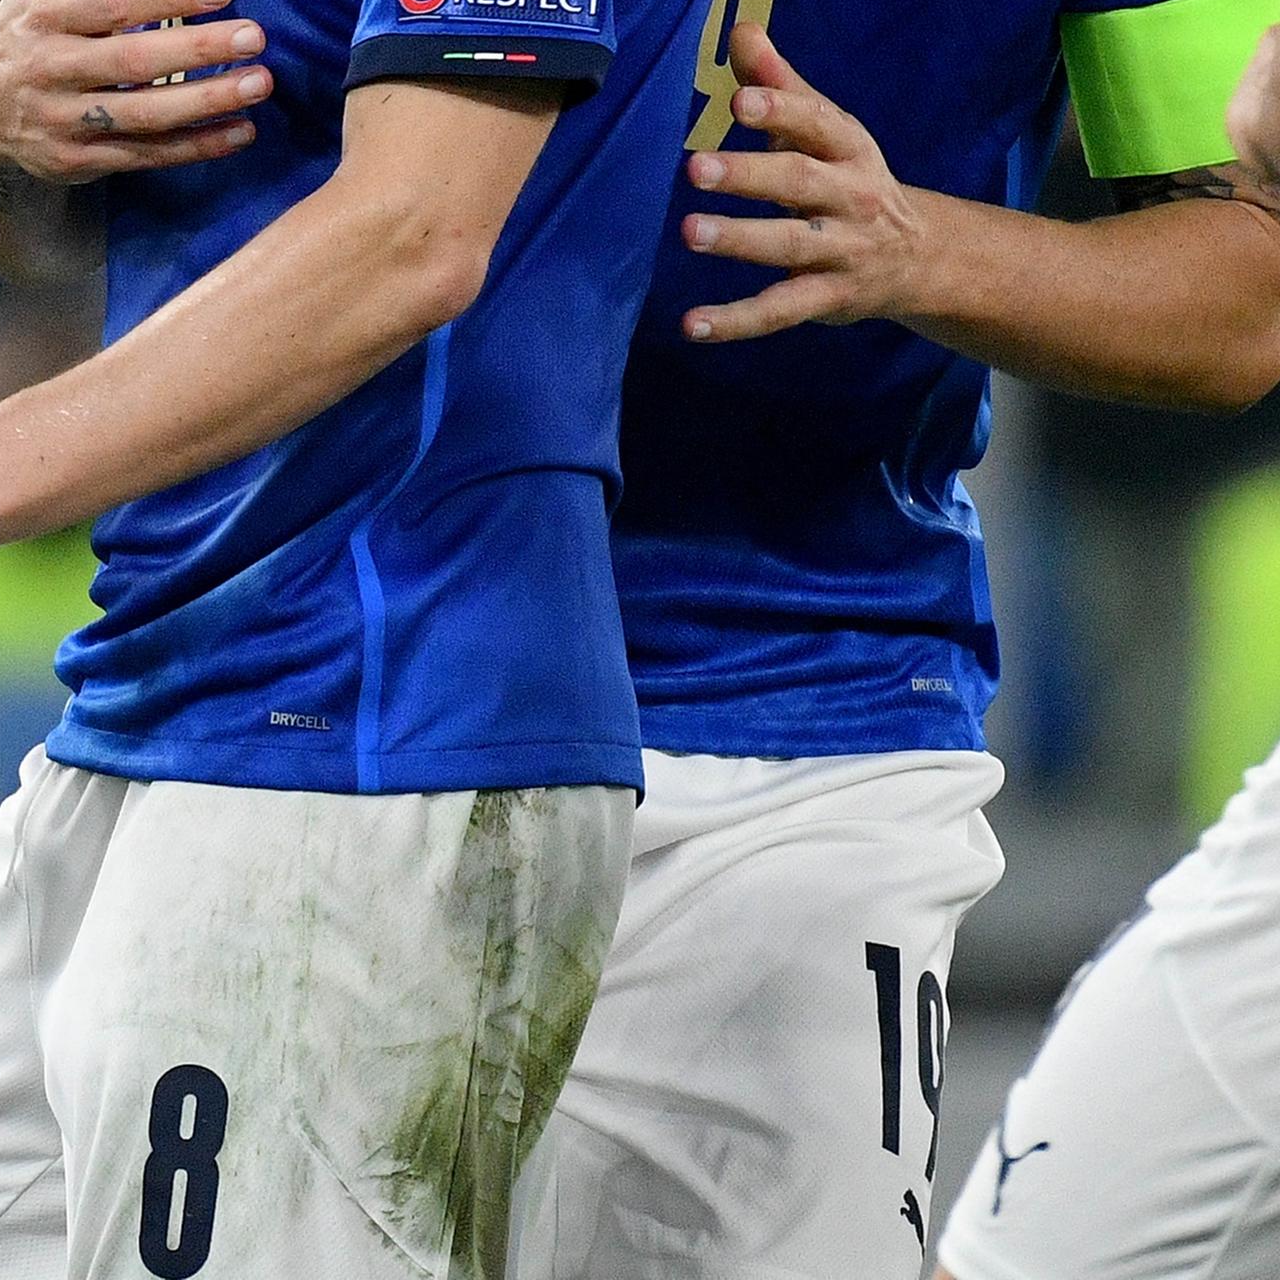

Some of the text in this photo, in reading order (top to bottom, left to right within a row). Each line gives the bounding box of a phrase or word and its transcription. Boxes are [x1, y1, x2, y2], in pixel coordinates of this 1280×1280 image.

[270, 711, 331, 730] DRYCELL
[865, 941, 943, 1183] 19
[138, 1063, 229, 1280] 8
